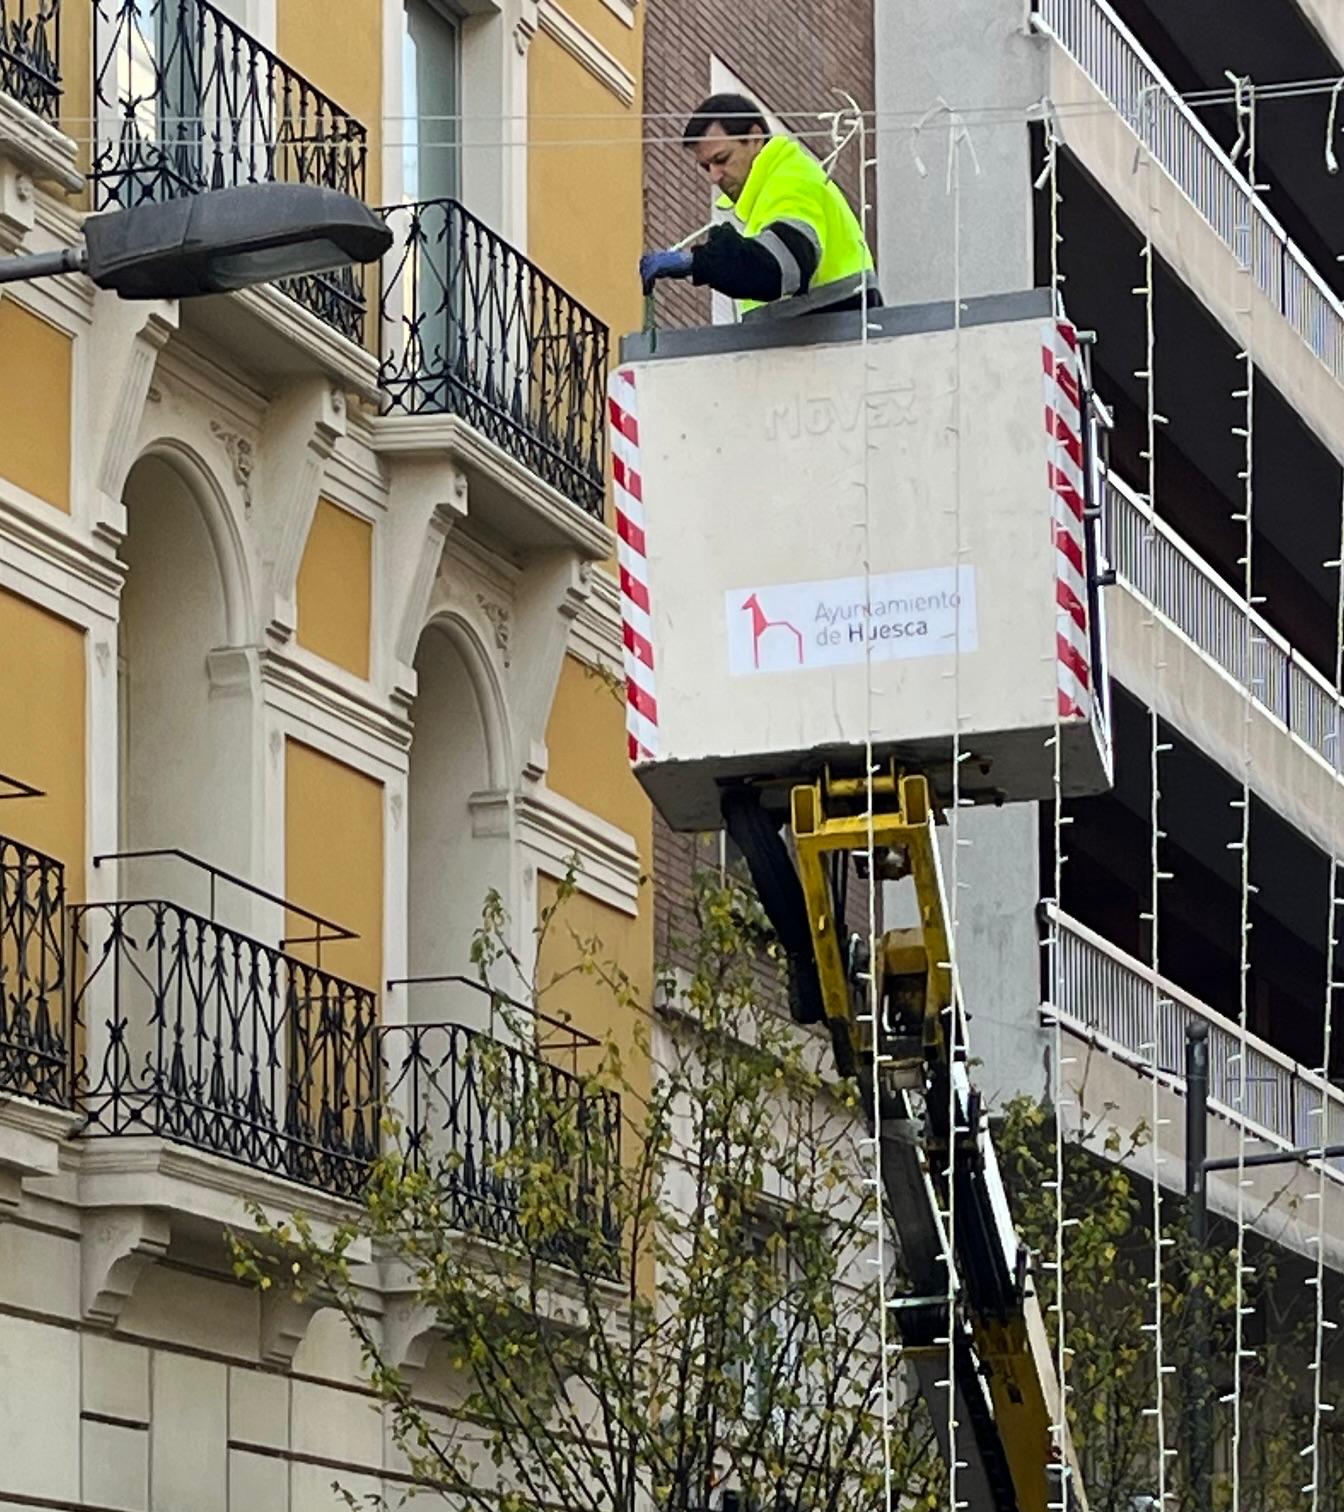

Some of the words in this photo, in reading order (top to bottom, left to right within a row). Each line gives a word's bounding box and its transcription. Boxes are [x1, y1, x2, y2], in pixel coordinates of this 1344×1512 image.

[814, 590, 961, 625] Ayuntamiento
[816, 629, 842, 647] de
[848, 619, 929, 644] Huesca
